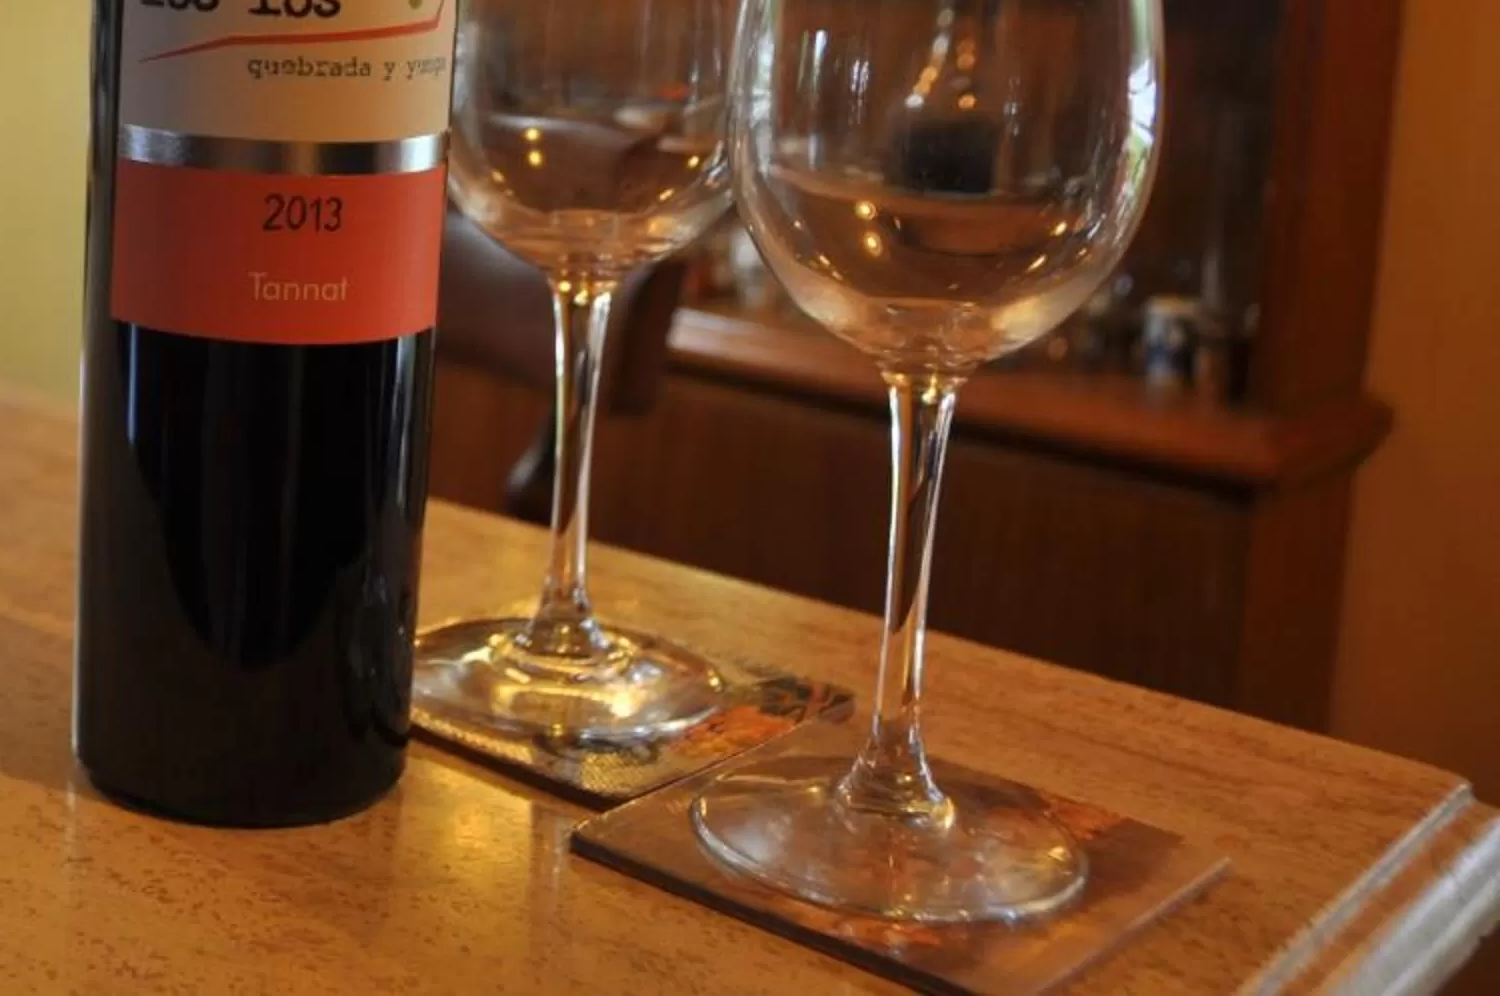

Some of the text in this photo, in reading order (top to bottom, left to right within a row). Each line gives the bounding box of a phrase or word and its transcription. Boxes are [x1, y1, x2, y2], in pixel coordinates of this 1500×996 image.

[247, 55, 372, 80] quebrada
[383, 60, 396, 81] y
[262, 192, 343, 233] 2013
[248, 271, 349, 301] Tannat
